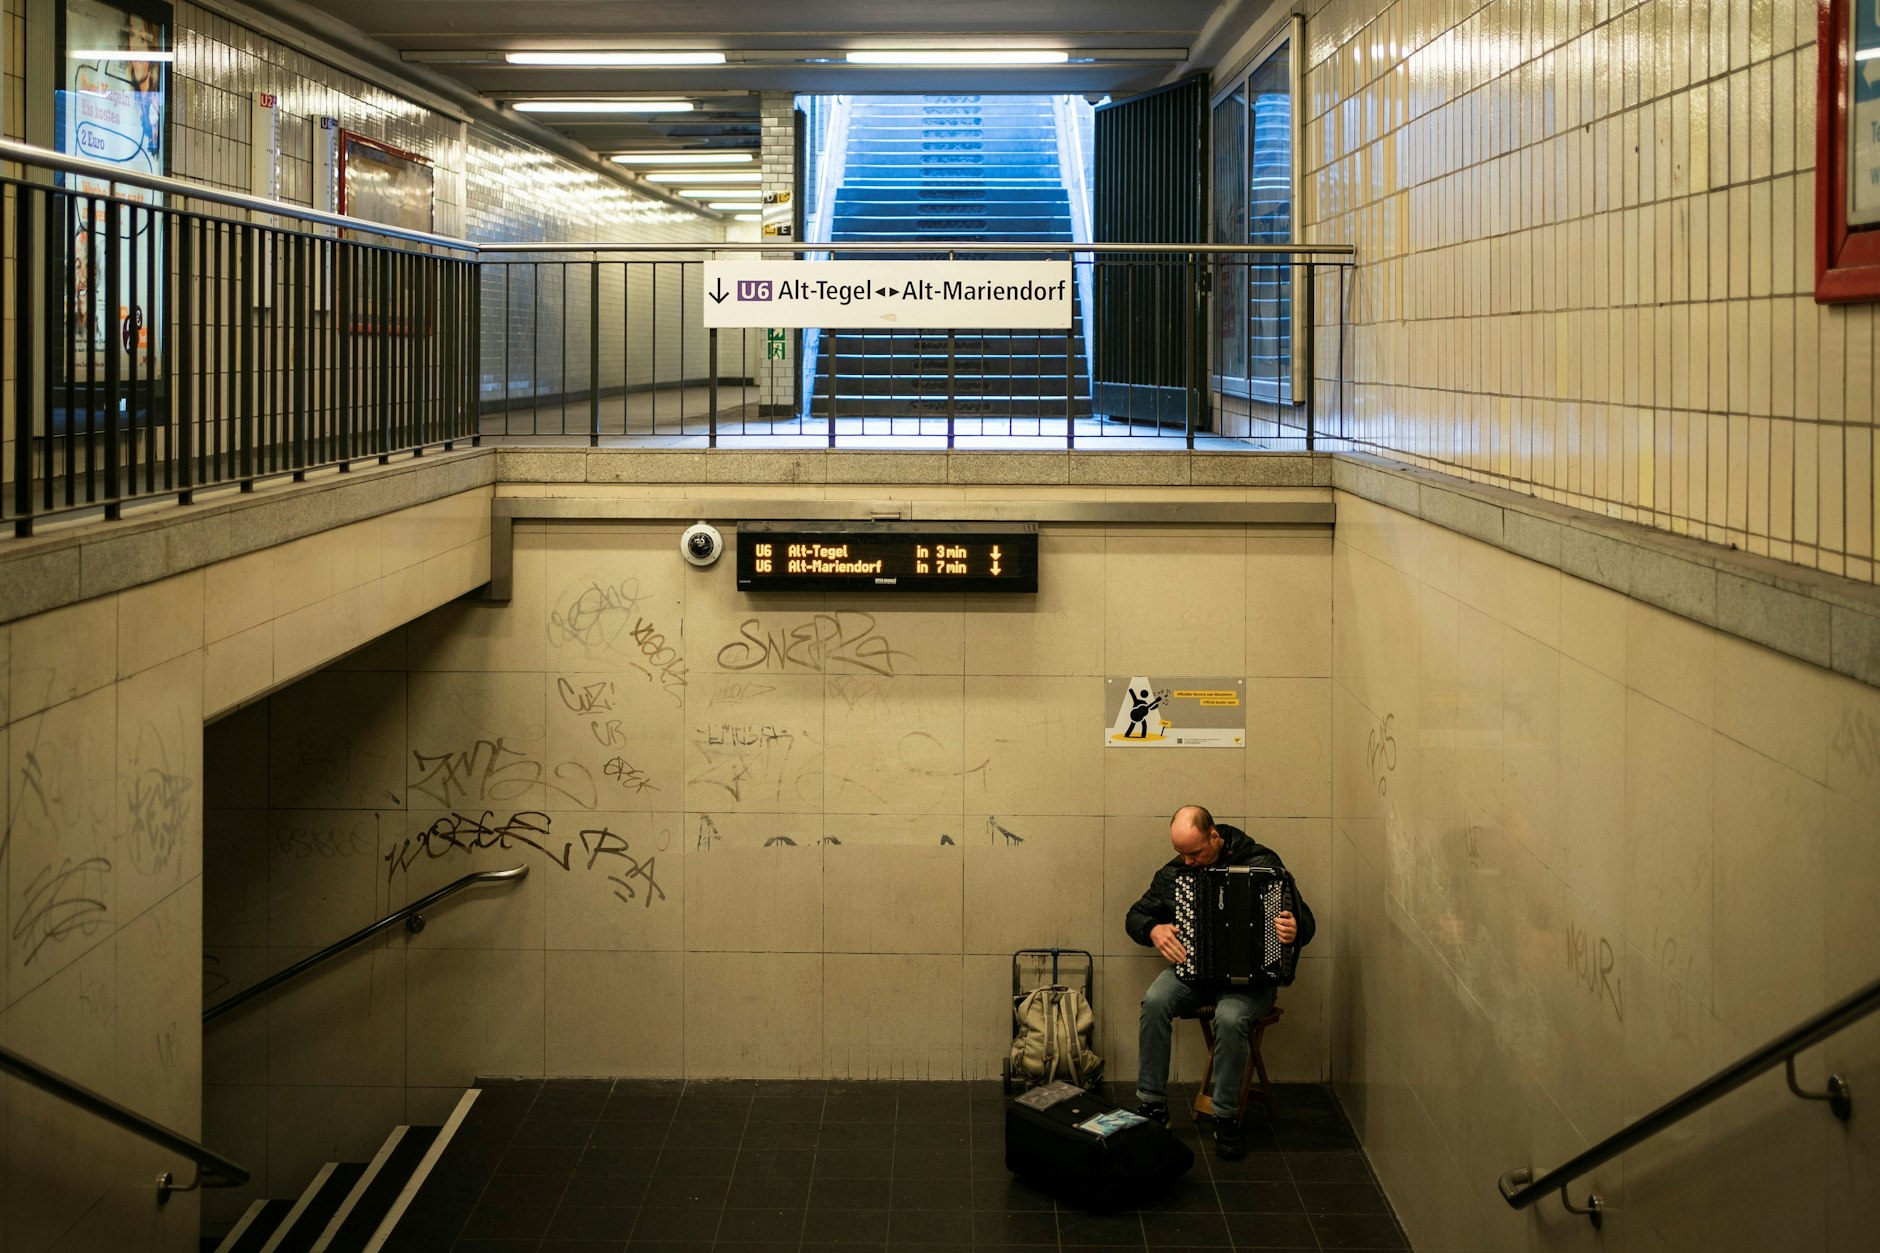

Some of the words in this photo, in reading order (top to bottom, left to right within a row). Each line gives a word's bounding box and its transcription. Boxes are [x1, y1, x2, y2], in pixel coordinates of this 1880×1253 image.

[261, 94, 274, 107] U2
[81, 129, 87, 145] 2
[88, 131, 105, 150] Euro
[741, 283, 769, 299] U6
[779, 279, 871, 305] Alt-Tegel
[902, 279, 1066, 301] Alt-Mariendorf
[756, 544, 772, 558] U6
[788, 544, 848, 559] Alt-Tegel
[916, 544, 929, 559] in
[756, 559, 772, 574] U6
[788, 560, 882, 574] Alt-Mariendorf
[916, 560, 929, 574] in
